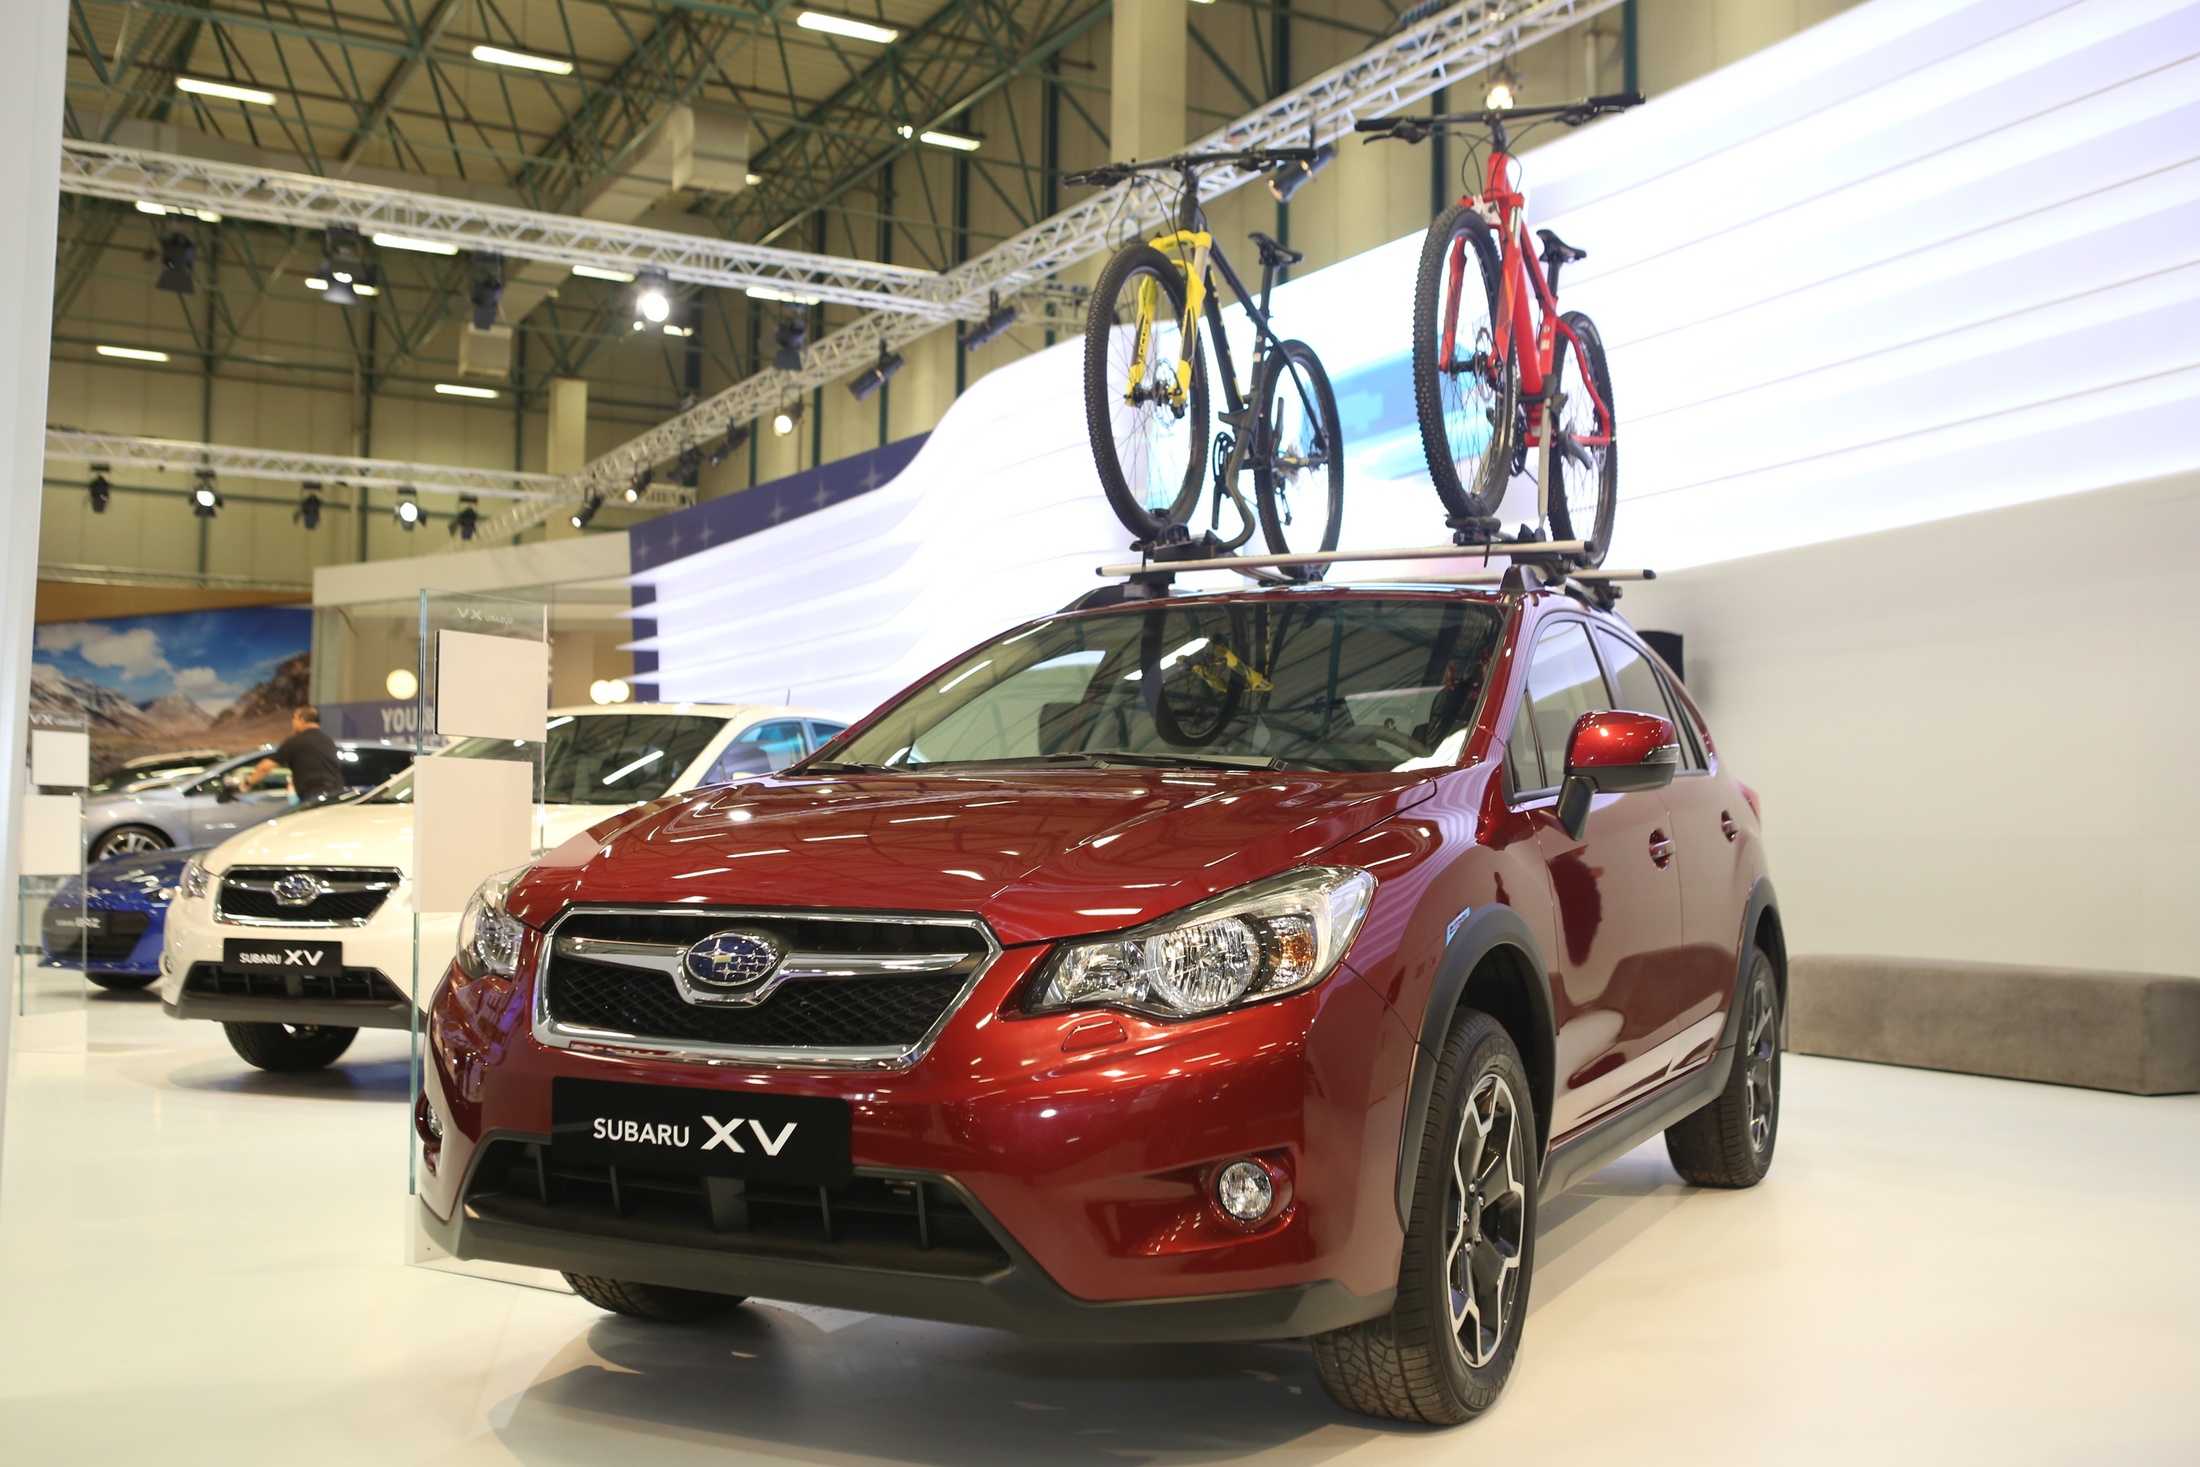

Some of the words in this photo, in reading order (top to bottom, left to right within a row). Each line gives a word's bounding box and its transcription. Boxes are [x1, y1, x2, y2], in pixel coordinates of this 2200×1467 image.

[239, 952, 282, 965] SUBARU
[284, 949, 324, 966] XV
[593, 1117, 690, 1148] SUBARU
[700, 1115, 799, 1157] XV
